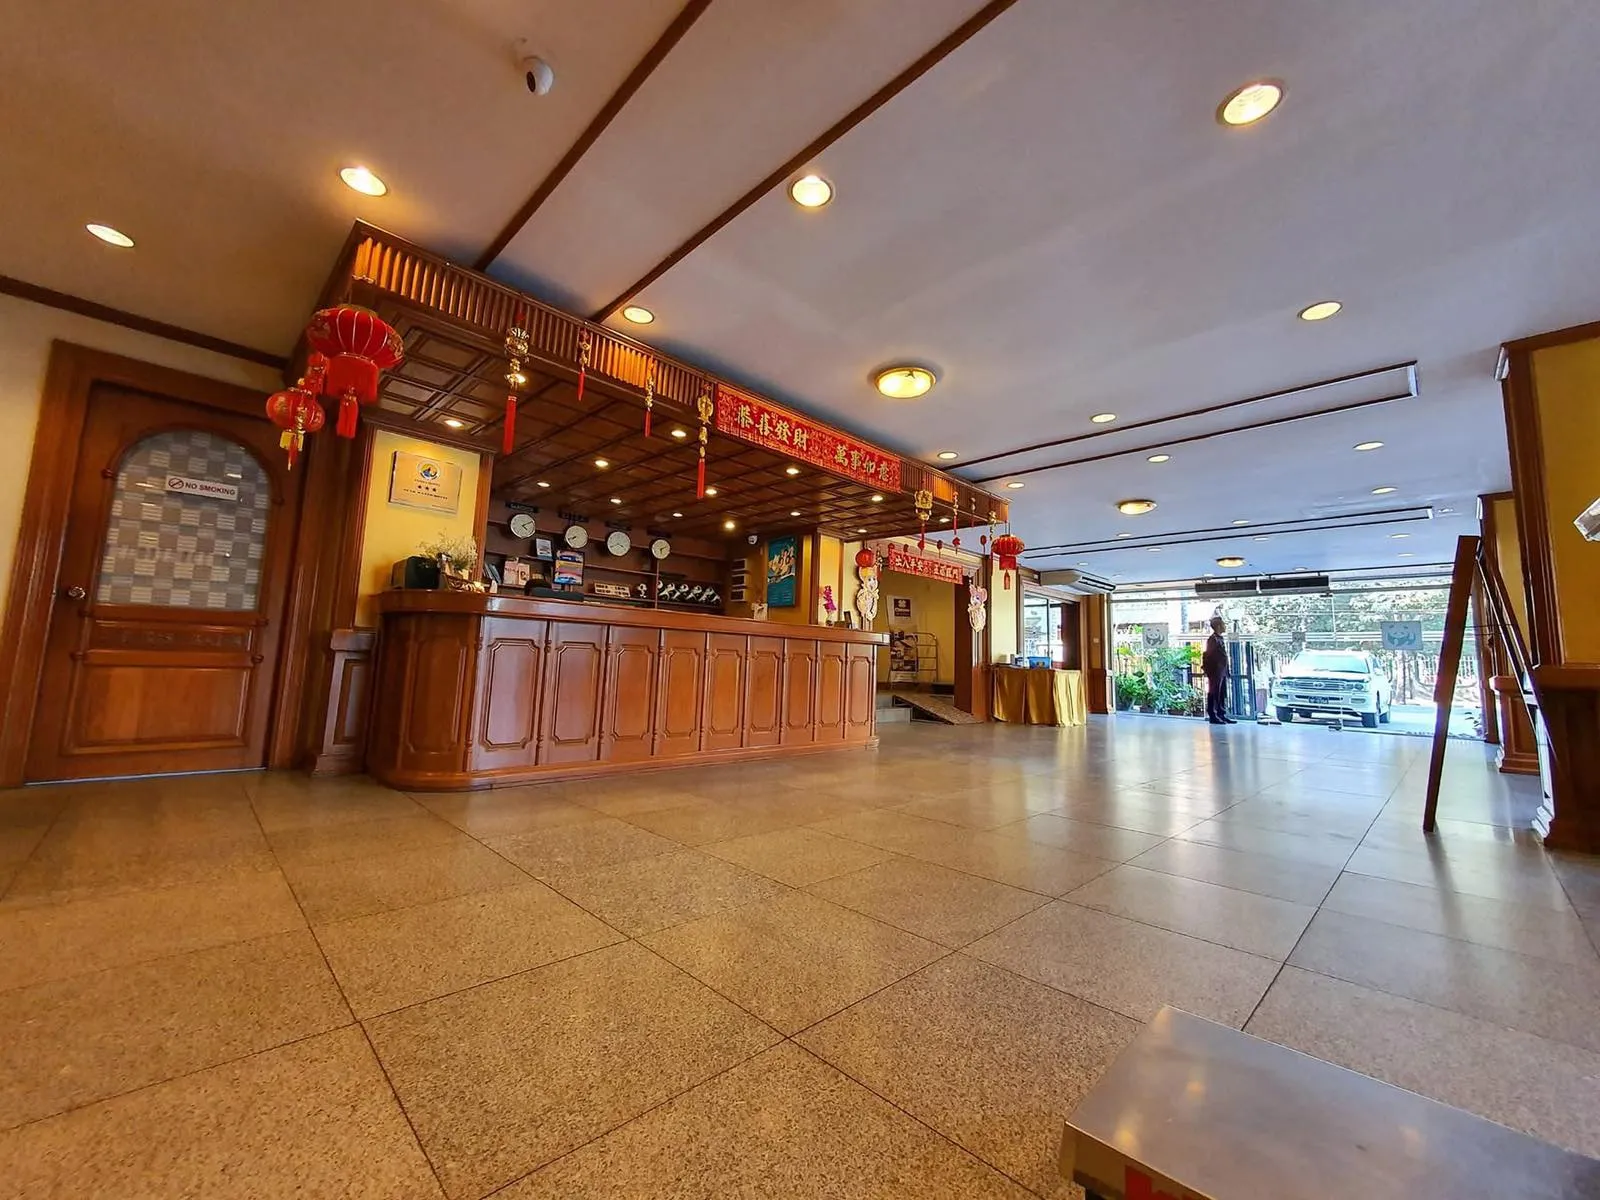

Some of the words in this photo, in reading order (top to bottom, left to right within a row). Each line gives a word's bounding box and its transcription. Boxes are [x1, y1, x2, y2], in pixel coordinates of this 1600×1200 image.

[736, 404, 808, 450] 恭喜發財
[834, 444, 889, 481] 萬事如意
[198, 484, 236, 496] SMOKING
